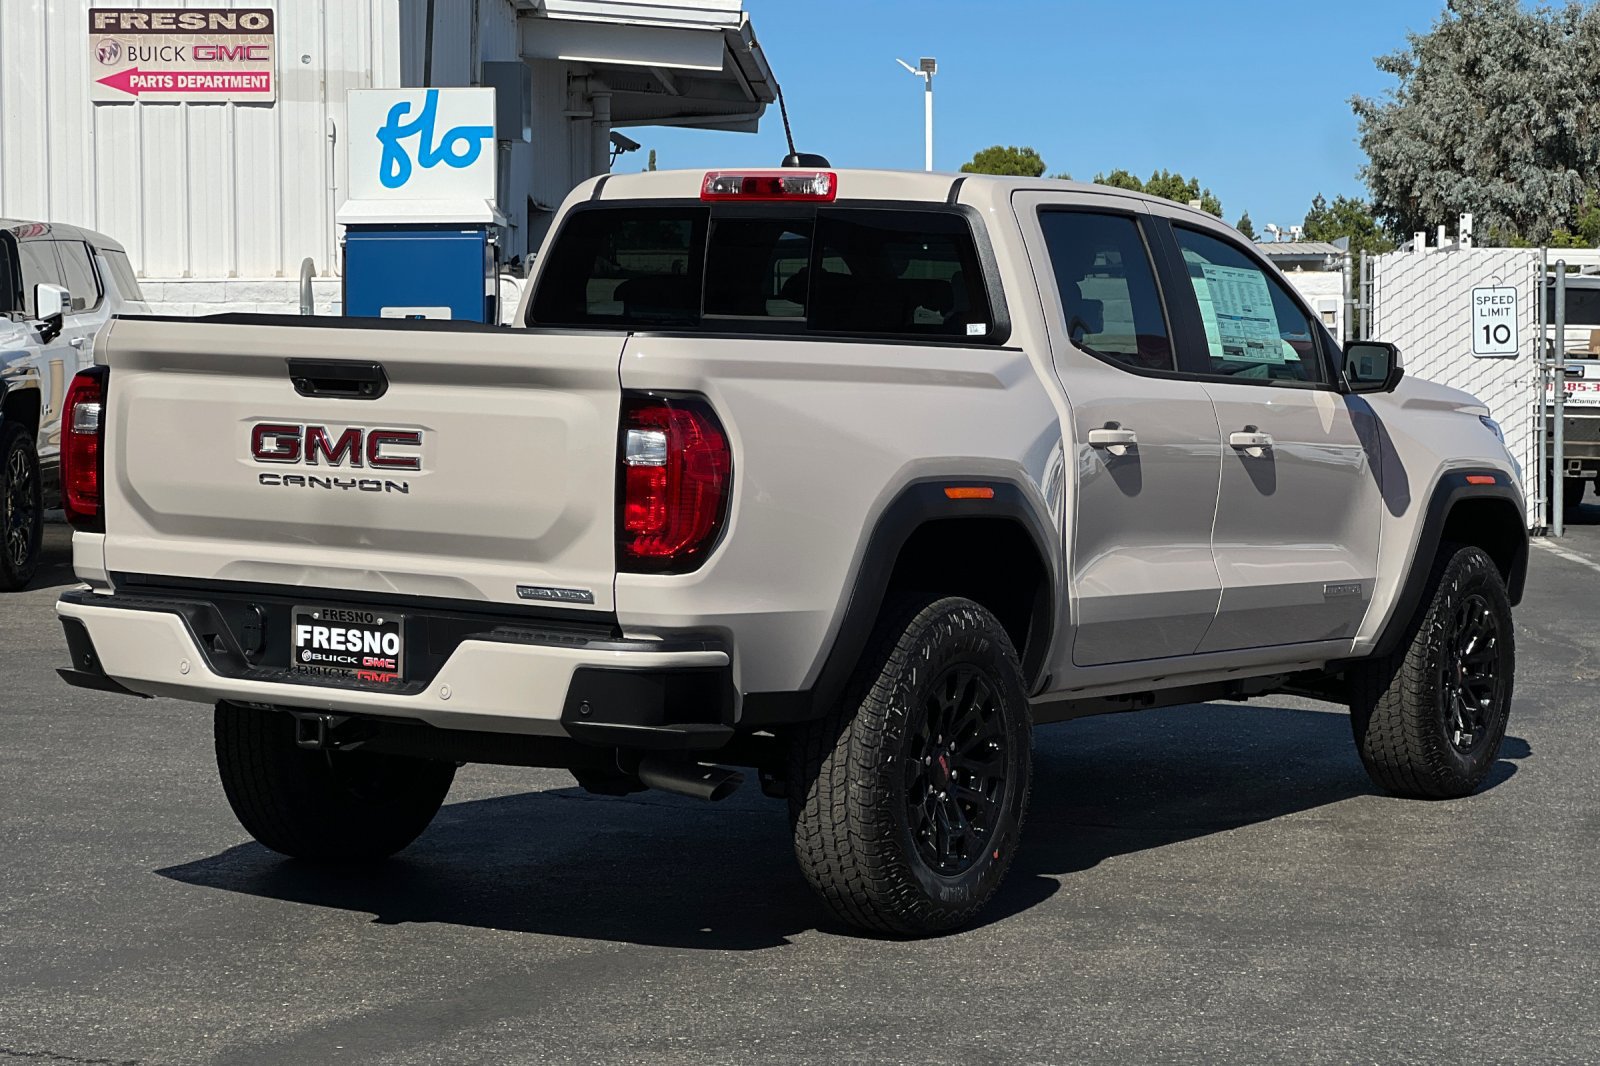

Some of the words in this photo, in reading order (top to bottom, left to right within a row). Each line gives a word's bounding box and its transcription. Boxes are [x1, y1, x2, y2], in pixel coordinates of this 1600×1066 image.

[94, 12, 270, 30] FRESNO
[127, 46, 186, 62] BUICK
[192, 44, 270, 63] GMC
[129, 75, 174, 88] PARTS
[177, 75, 268, 88] DEPARTMENT
[376, 89, 494, 189] flo
[1476, 295, 1514, 305] SPEED
[1480, 307, 1511, 317] LIMIT
[1482, 323, 1511, 345] 10
[251, 422, 422, 471] GMC
[258, 473, 409, 494] CANYON
[322, 609, 374, 623] FRESNO
[296, 624, 400, 656] FRESNO
[312, 653, 358, 664] BUICK
[362, 656, 396, 669] GMC
[357, 669, 399, 683] GMC
